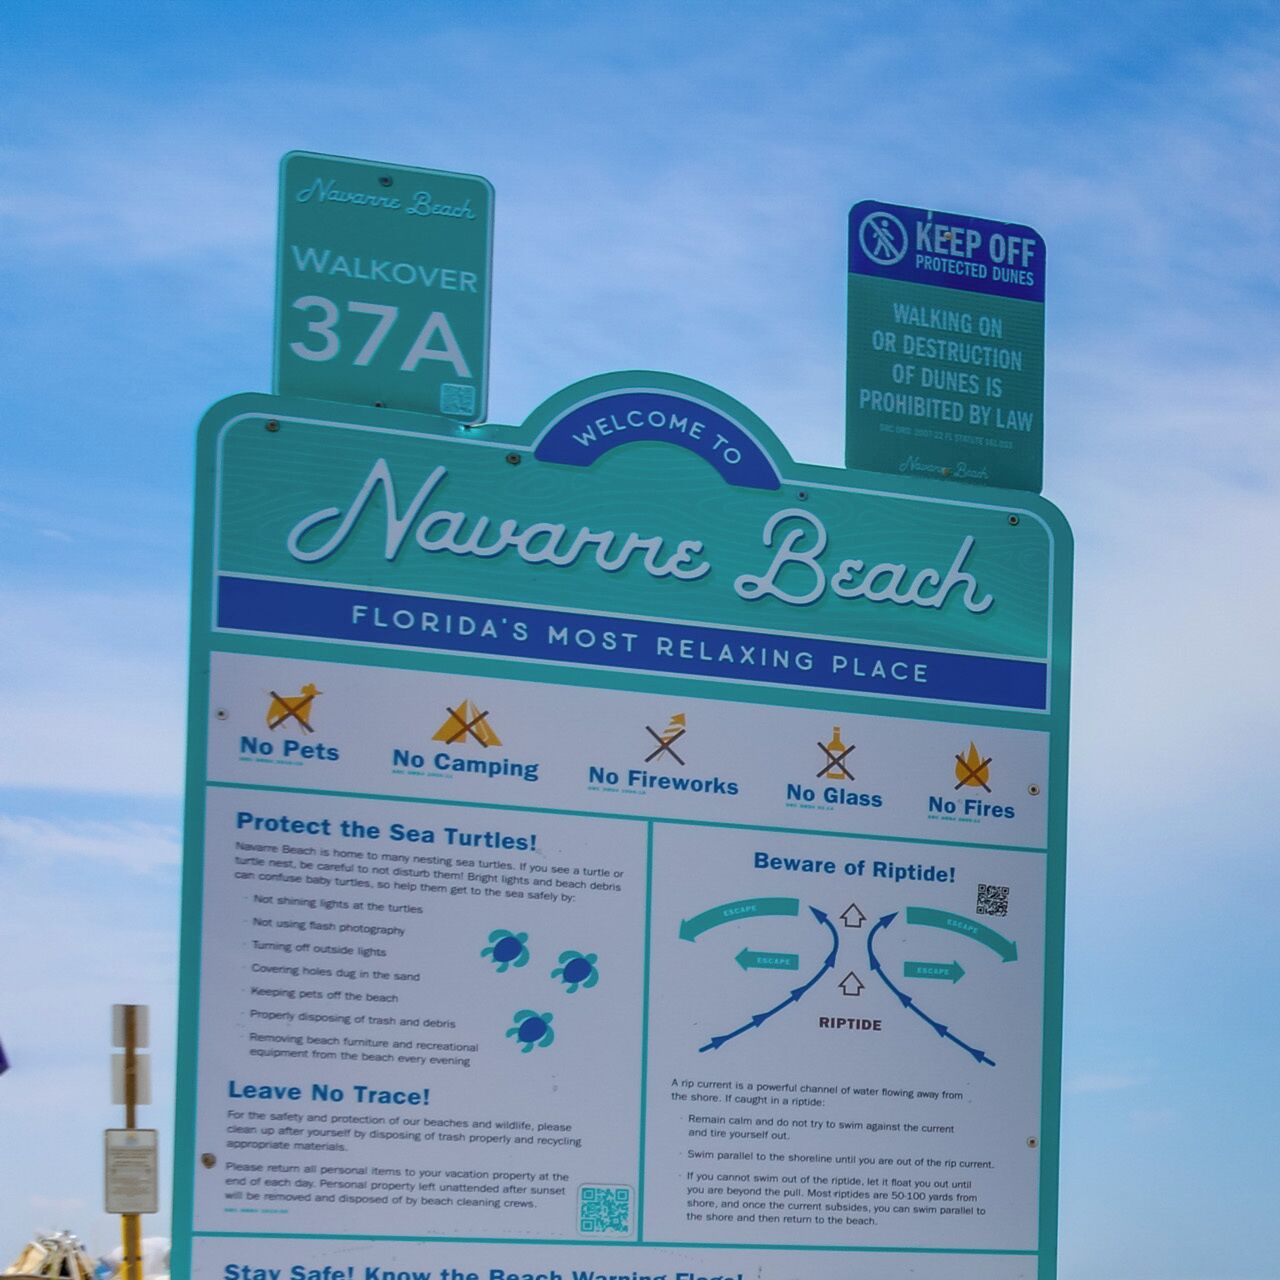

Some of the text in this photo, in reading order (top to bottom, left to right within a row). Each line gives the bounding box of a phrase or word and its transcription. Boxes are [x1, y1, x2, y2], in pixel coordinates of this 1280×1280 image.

[296, 177, 476, 220] Navarre Beach
[916, 221, 1036, 268] KEEP OFF
[291, 245, 477, 293] WALKOVER
[916, 254, 1034, 286] PROTECTED DUNES
[893, 303, 1003, 338] WALKING ON
[289, 295, 472, 378] 37A
[872, 330, 1022, 371] OR DESTRUCTION
[892, 364, 1003, 397] OF DUNES IS
[860, 389, 1033, 432] PROHIBITED BY LAW
[572, 410, 741, 464] WELCOME TO
[286, 457, 995, 615] Navarre Beach
[351, 605, 929, 683] FLORIDA'S MOST RELAXING PLACE
[240, 736, 339, 761] No Pets
[393, 749, 424, 768] No
[434, 753, 540, 782] Camping
[589, 766, 618, 784] No
[628, 770, 738, 795] Fireworks
[787, 783, 883, 808] No Glass
[928, 796, 956, 814] No
[964, 799, 1015, 819] Fires
[236, 812, 538, 852] Protect the Sea Turtles!
[754, 852, 955, 882] Beware of Riptide!
[254, 894, 423, 914] Not shining lights at the turtles
[723, 905, 757, 917] ESCAPE
[253, 917, 405, 936] Not using flash photography
[946, 918, 979, 934] ESCAPE
[756, 956, 791, 965] ESCAPE
[916, 967, 949, 976] ESCAPE
[819, 1016, 882, 1031] RIPTIDE
[228, 1080, 430, 1106] Leave No Trace!
[671, 1078, 678, 1087] A
[682, 1080, 694, 1089] rip
[757, 1083, 797, 1092] powerful
[800, 1086, 837, 1094] channel
[841, 1087, 850, 1095] of
[853, 1088, 878, 1096] water
[882, 1088, 914, 1099] flowing
[917, 1091, 939, 1100] away
[942, 1091, 963, 1100] from
[672, 1092, 687, 1100] the
[691, 1094, 721, 1102] shore.
[735, 1095, 767, 1105] caught
[792, 1099, 825, 1107] riptide:
